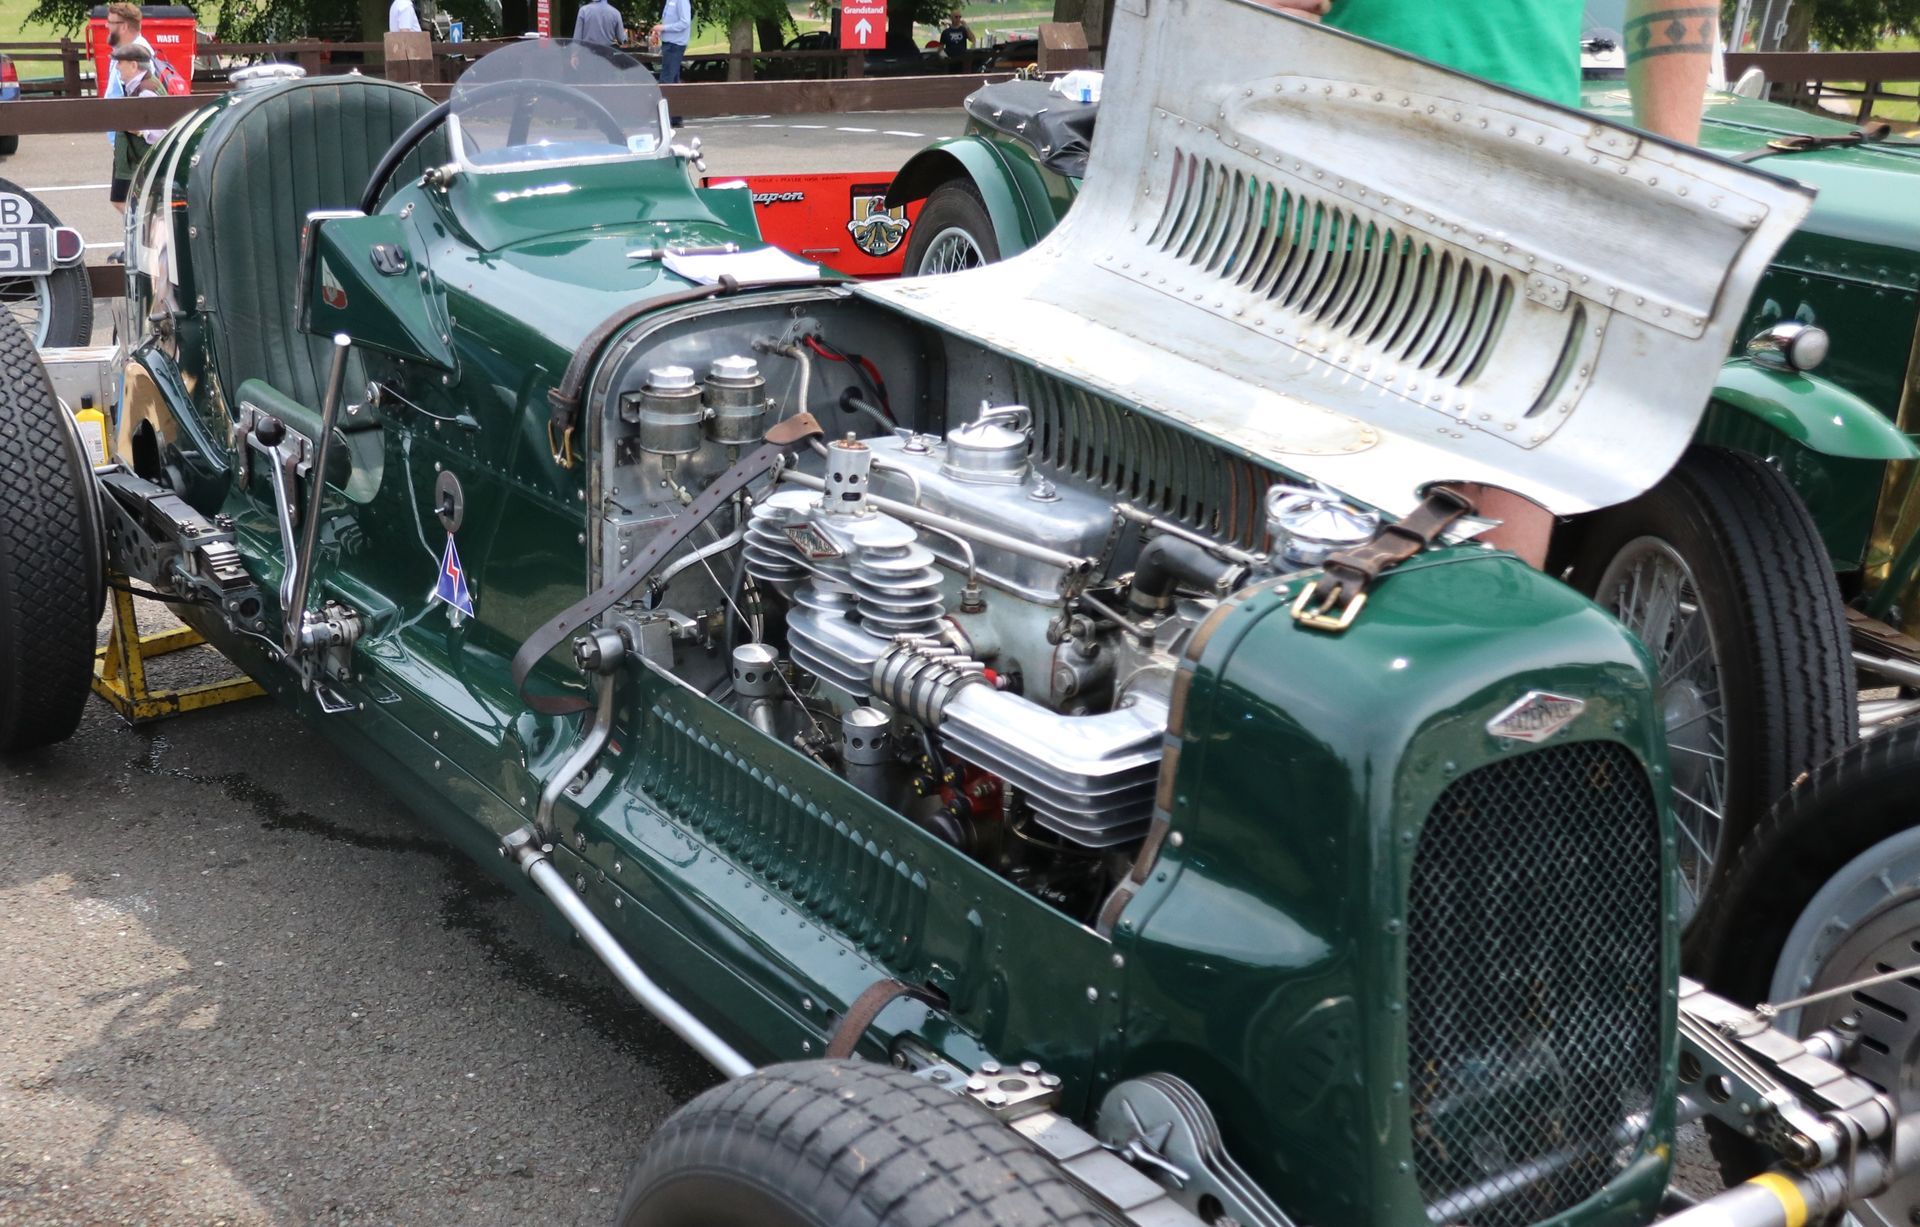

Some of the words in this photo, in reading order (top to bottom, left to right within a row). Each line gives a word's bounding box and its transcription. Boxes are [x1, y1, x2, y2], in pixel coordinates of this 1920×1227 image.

[844, 6, 884, 14] Grandstand
[156, 34, 180, 43] WASTE
[752, 191, 804, 205] nap-on
